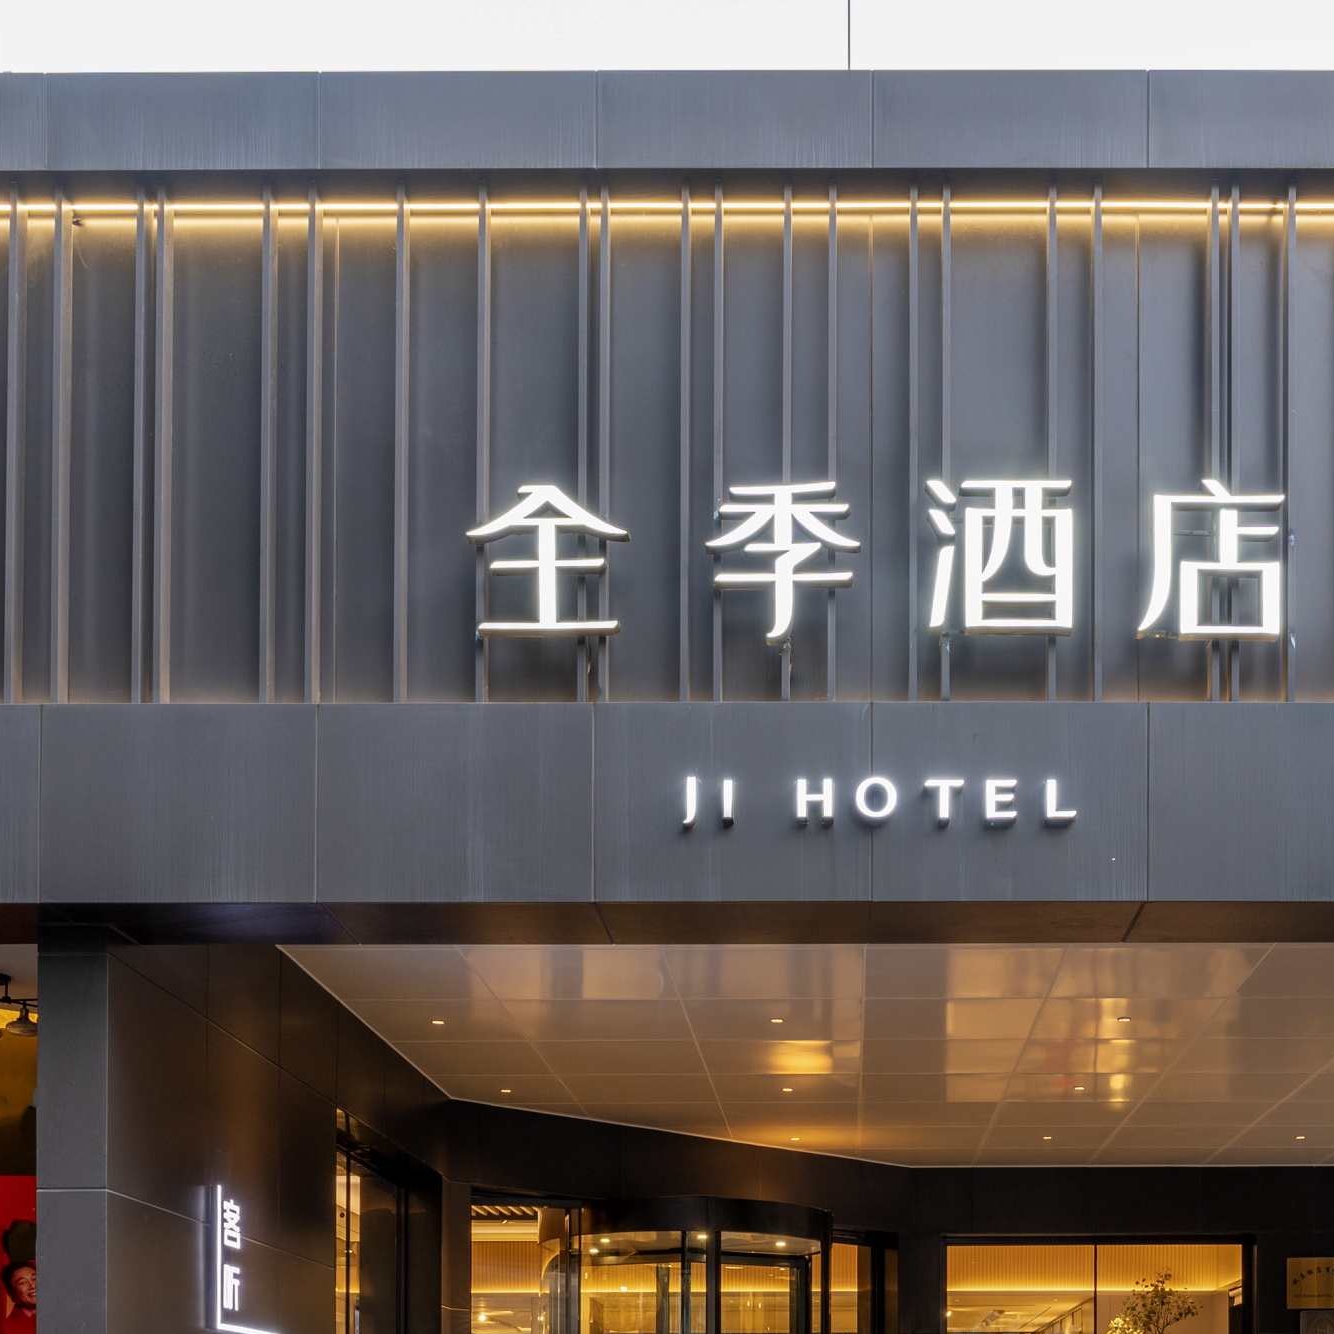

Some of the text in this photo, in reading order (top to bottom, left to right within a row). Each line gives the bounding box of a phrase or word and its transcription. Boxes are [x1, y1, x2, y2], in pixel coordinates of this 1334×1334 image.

[466, 478, 1286, 646] 全季酒店
[682, 775, 1078, 829] JI HOTEL
